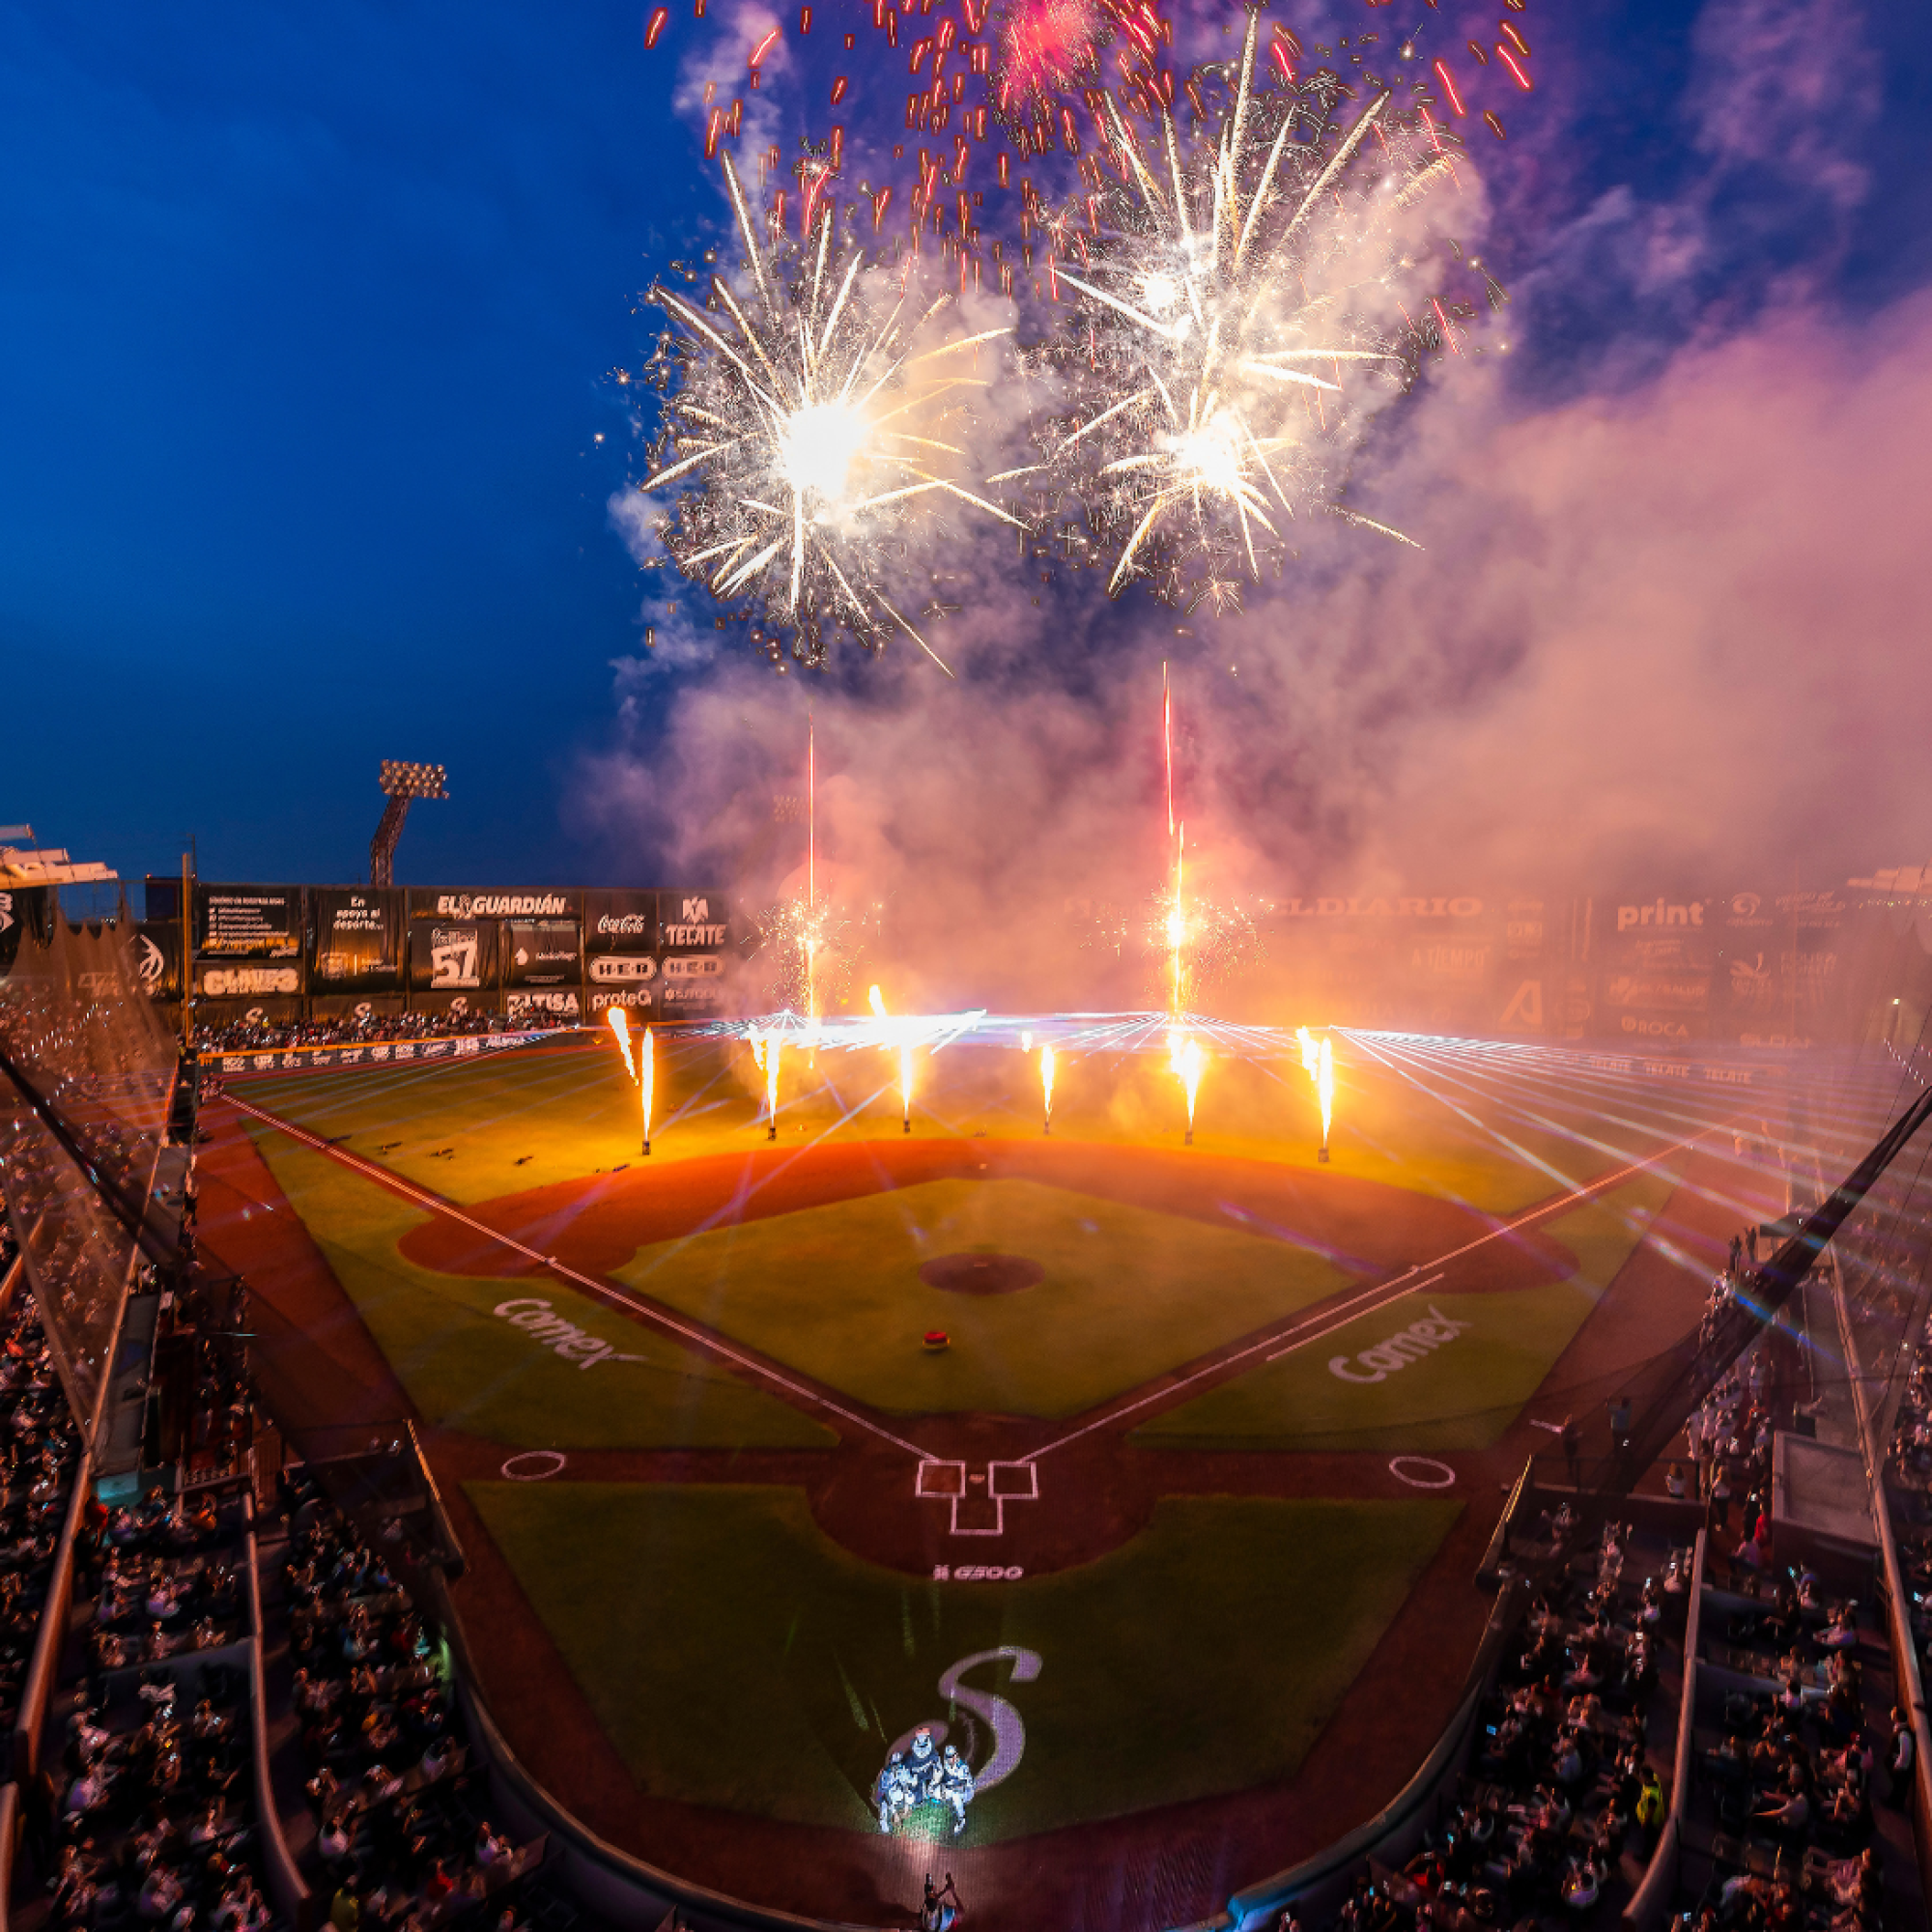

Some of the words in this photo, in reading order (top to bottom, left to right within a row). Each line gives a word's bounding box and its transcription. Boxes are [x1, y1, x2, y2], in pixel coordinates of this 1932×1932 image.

[351, 895, 366, 907] En
[438, 895, 460, 915] EL
[470, 893, 566, 915] GUARDIÁN
[1317, 896, 1485, 918] DIARIO
[1617, 897, 1704, 932] print
[666, 924, 728, 946] TECATE
[431, 941, 478, 978] 57
[494, 1298, 649, 1370] Comex
[1328, 1304, 1474, 1383] Comex
